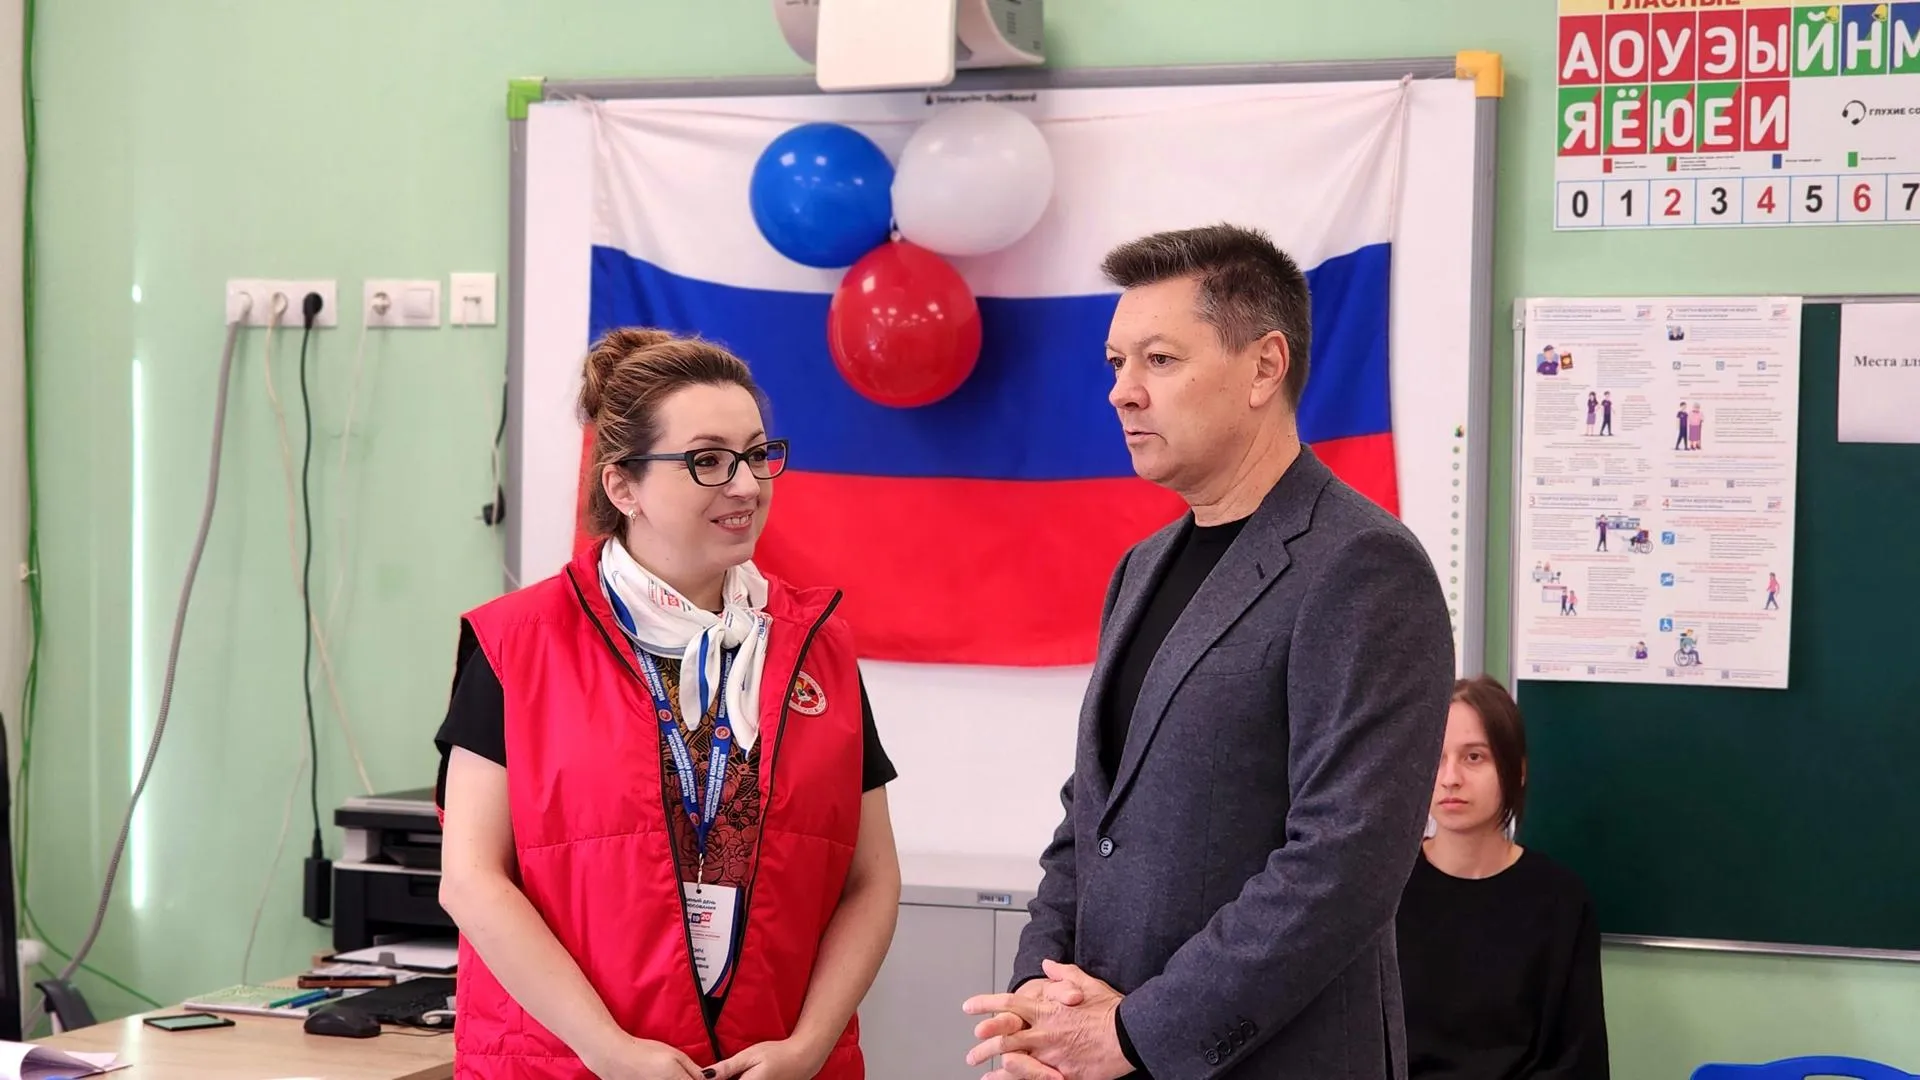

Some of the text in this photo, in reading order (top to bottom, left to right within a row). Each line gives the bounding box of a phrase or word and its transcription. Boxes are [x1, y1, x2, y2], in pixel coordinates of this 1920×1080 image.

[1868, 107, 1906, 116] ГЛУХИЕ
[1571, 182, 1920, 219] 0 1 2 3 4 5 6 7
[1853, 355, 1920, 367] Места дл
[667, 734, 690, 797] МОСКОВСКОЙ ОБЛАСТИ
[671, 728, 697, 804] ИЗБИРАТЕЛЬНАЯ КОМИССИЯ
[717, 753, 727, 779] ОБЛАСТИ
